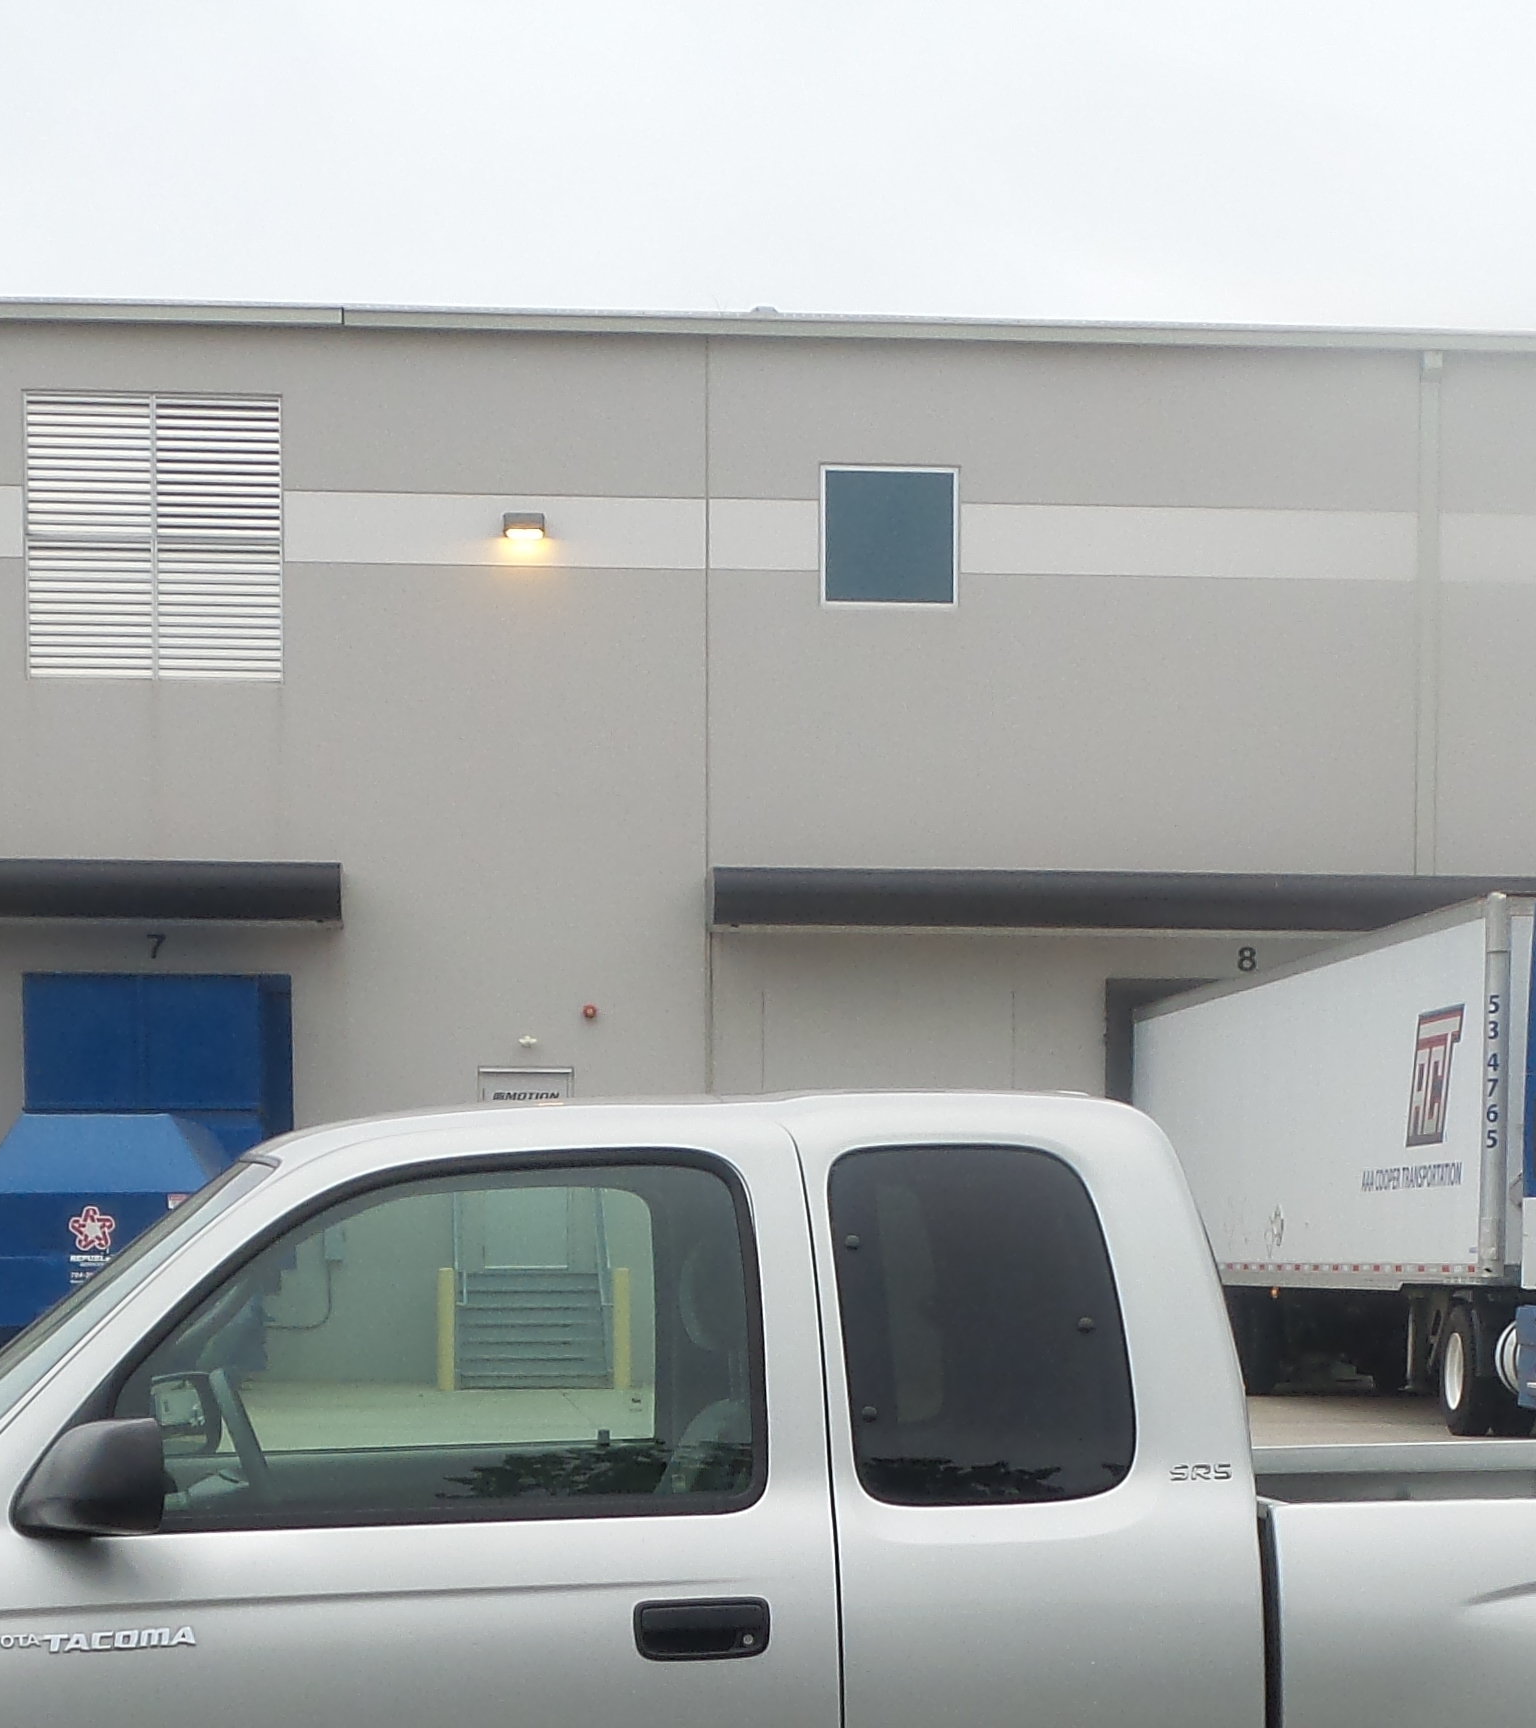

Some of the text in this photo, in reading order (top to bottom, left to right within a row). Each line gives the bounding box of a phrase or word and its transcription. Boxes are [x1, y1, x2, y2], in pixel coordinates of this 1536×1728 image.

[147, 934, 166, 959] 7
[1238, 946, 1257, 971] 8
[1409, 1010, 1464, 1142] ACT
[505, 1091, 560, 1101] MOTION
[1402, 1161, 1462, 1188] TRANSPORTATION
[1169, 1463, 1232, 1481] SR5
[41, 1626, 197, 1654] TACOMA
